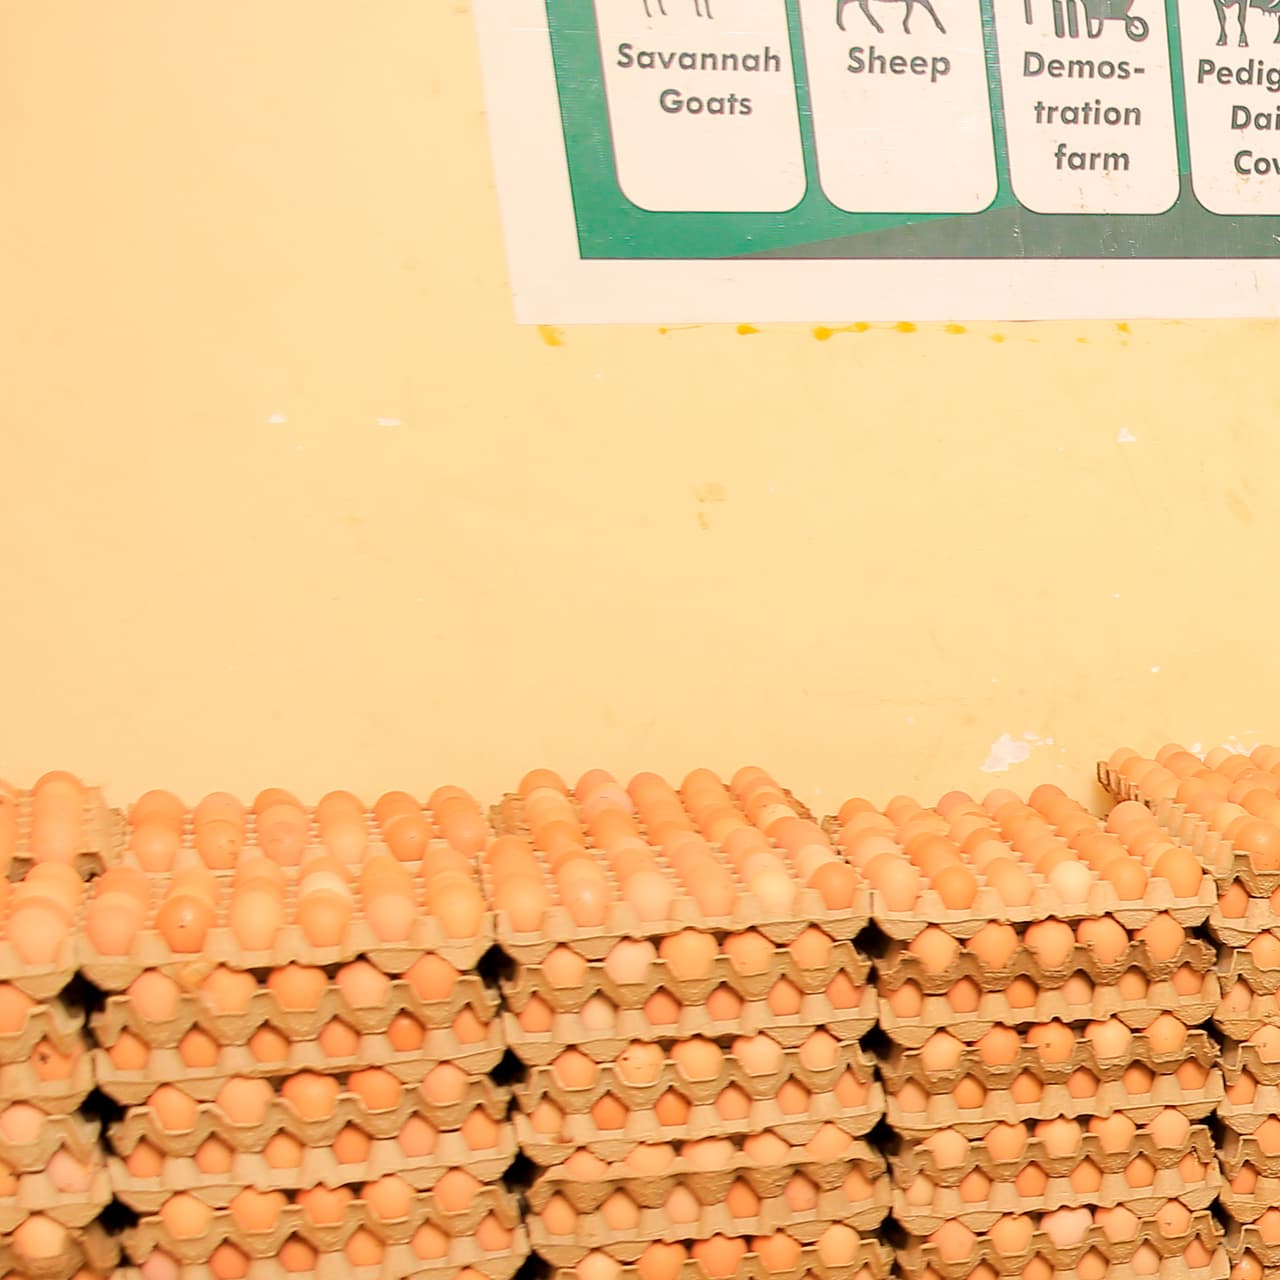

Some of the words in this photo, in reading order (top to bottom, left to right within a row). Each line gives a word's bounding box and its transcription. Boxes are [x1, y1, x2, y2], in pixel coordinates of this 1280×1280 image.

[616, 42, 782, 73] Savannah
[847, 45, 951, 83] Sheep
[1023, 51, 1145, 80] Demos-
[659, 88, 752, 116] Goats
[1033, 98, 1142, 126] tration
[1054, 142, 1130, 171] farm
